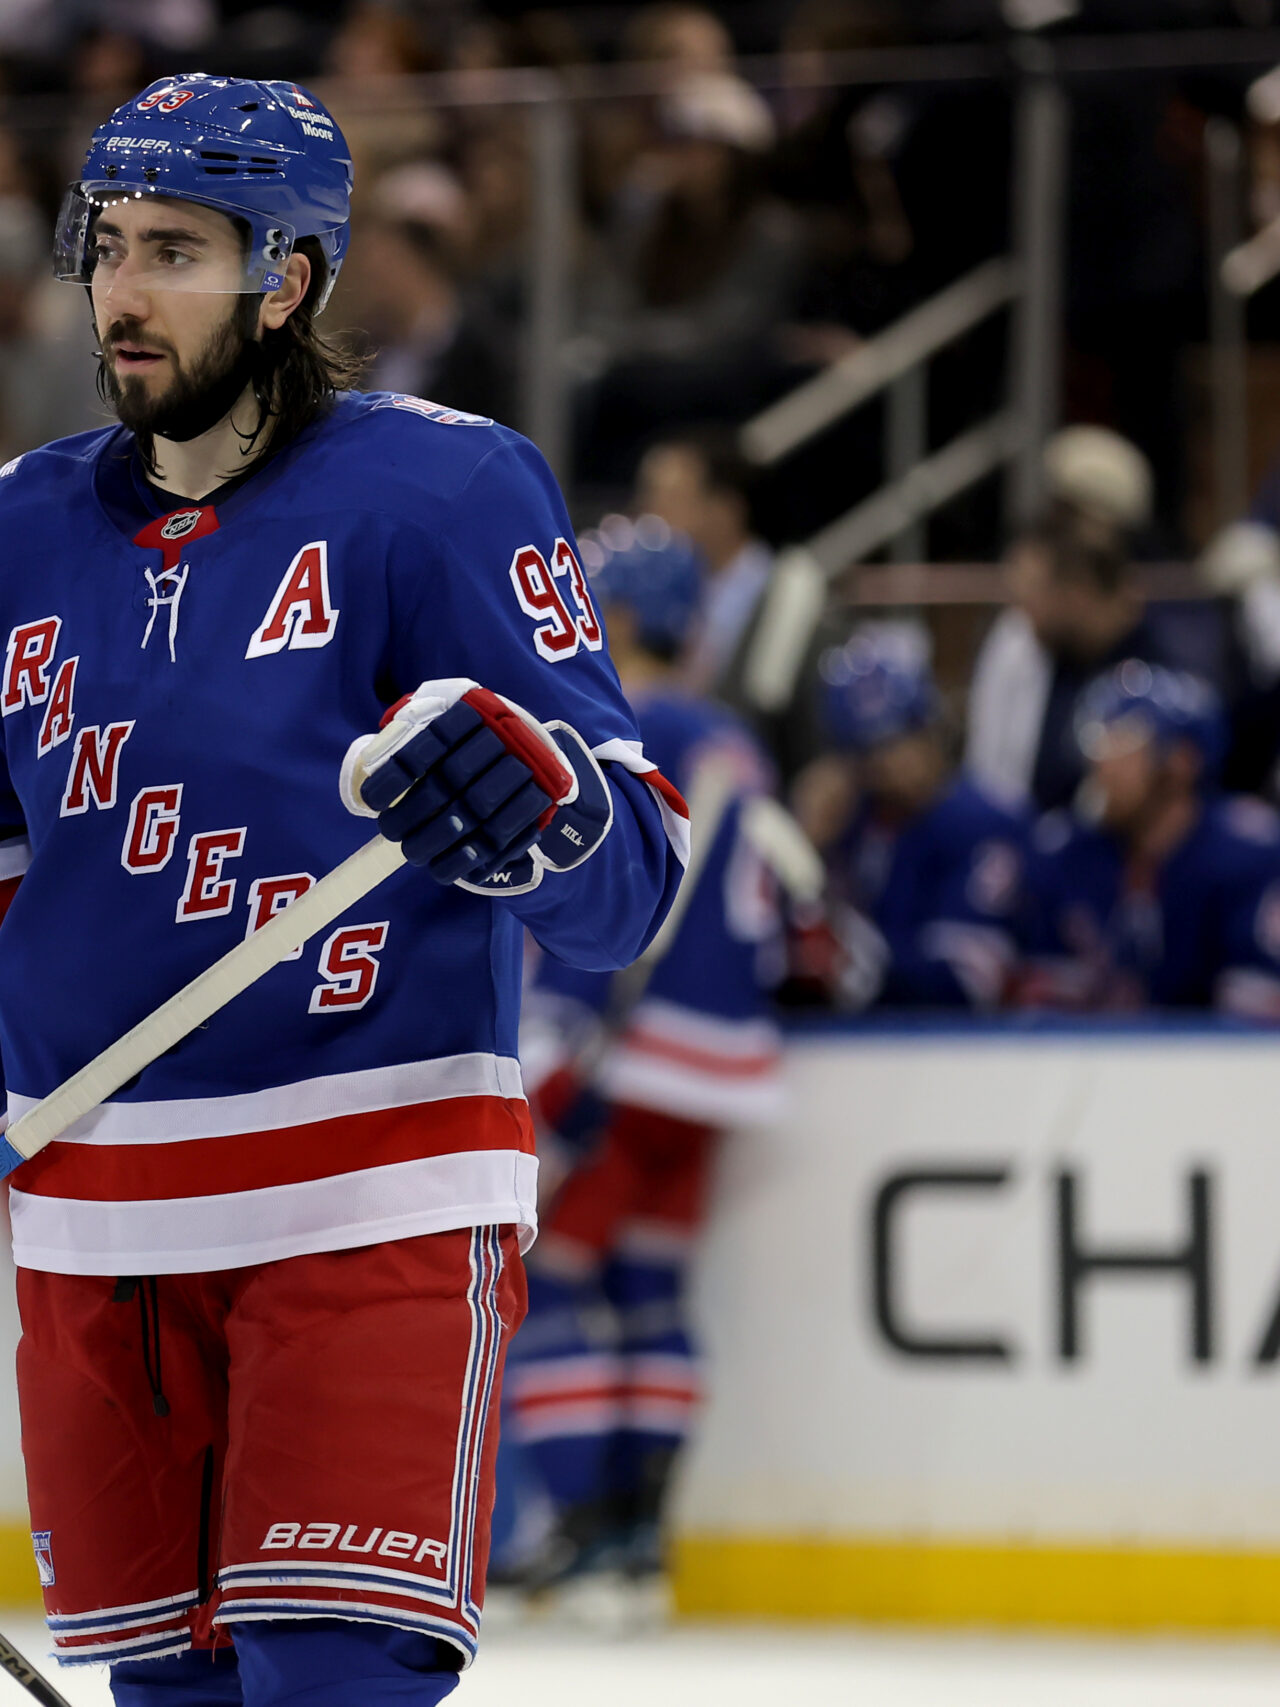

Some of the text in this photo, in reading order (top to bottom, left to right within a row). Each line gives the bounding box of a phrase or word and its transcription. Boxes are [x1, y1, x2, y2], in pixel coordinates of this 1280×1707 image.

[287, 105, 334, 128] Benjamin
[105, 135, 171, 151] BAUER
[301, 121, 334, 142] Moore
[245, 540, 340, 660] A
[508, 536, 603, 664] 93
[560, 823, 584, 847] MIKA
[260, 1522, 447, 1570] BAUER
